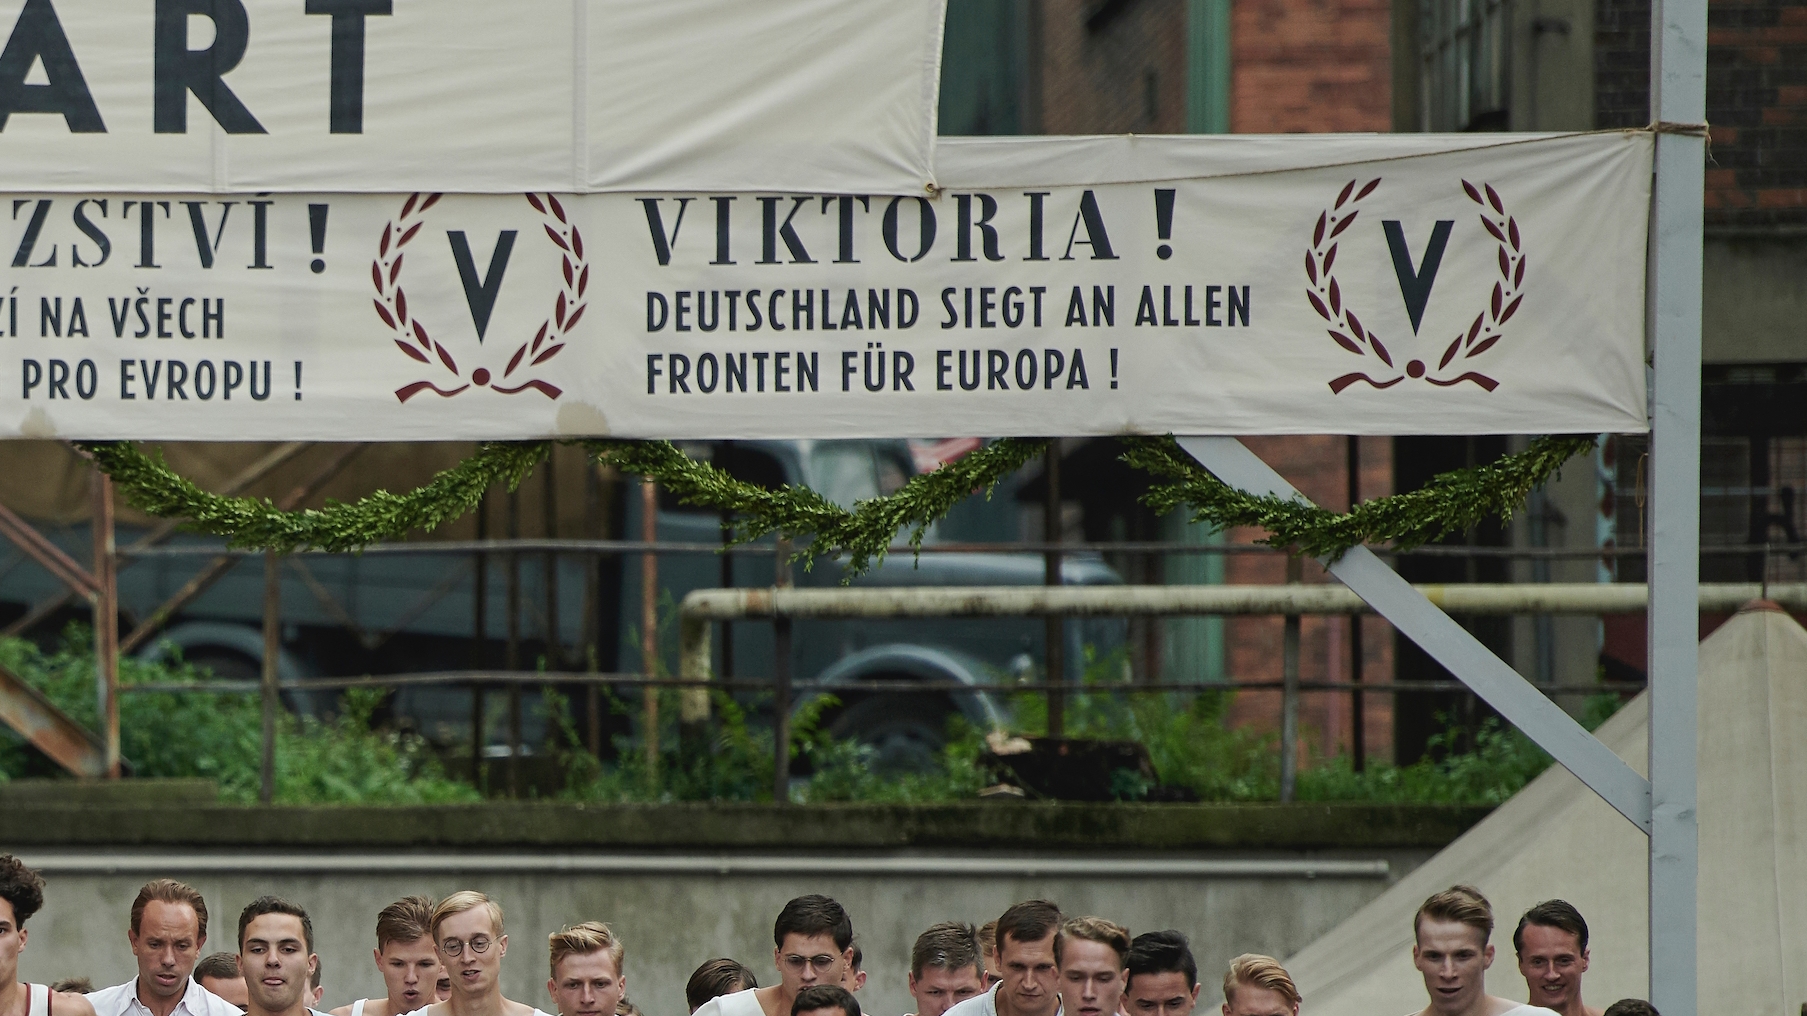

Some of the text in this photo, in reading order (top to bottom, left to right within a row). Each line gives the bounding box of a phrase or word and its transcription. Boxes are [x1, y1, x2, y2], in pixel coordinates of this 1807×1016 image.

[634, 190, 1121, 266] VIKTORIA
[447, 229, 517, 344] V
[1382, 220, 1455, 337] V
[40, 296, 89, 338] NA
[108, 286, 224, 340] VŠECH
[646, 285, 1251, 333] DEUTSCHLAND SIEGT AN ALLEN
[22, 358, 98, 400] PRO
[120, 359, 271, 401] EVROPU
[647, 351, 819, 395] FRONTEN
[841, 342, 915, 392] FÜR
[936, 348, 1090, 391] EUROPA
